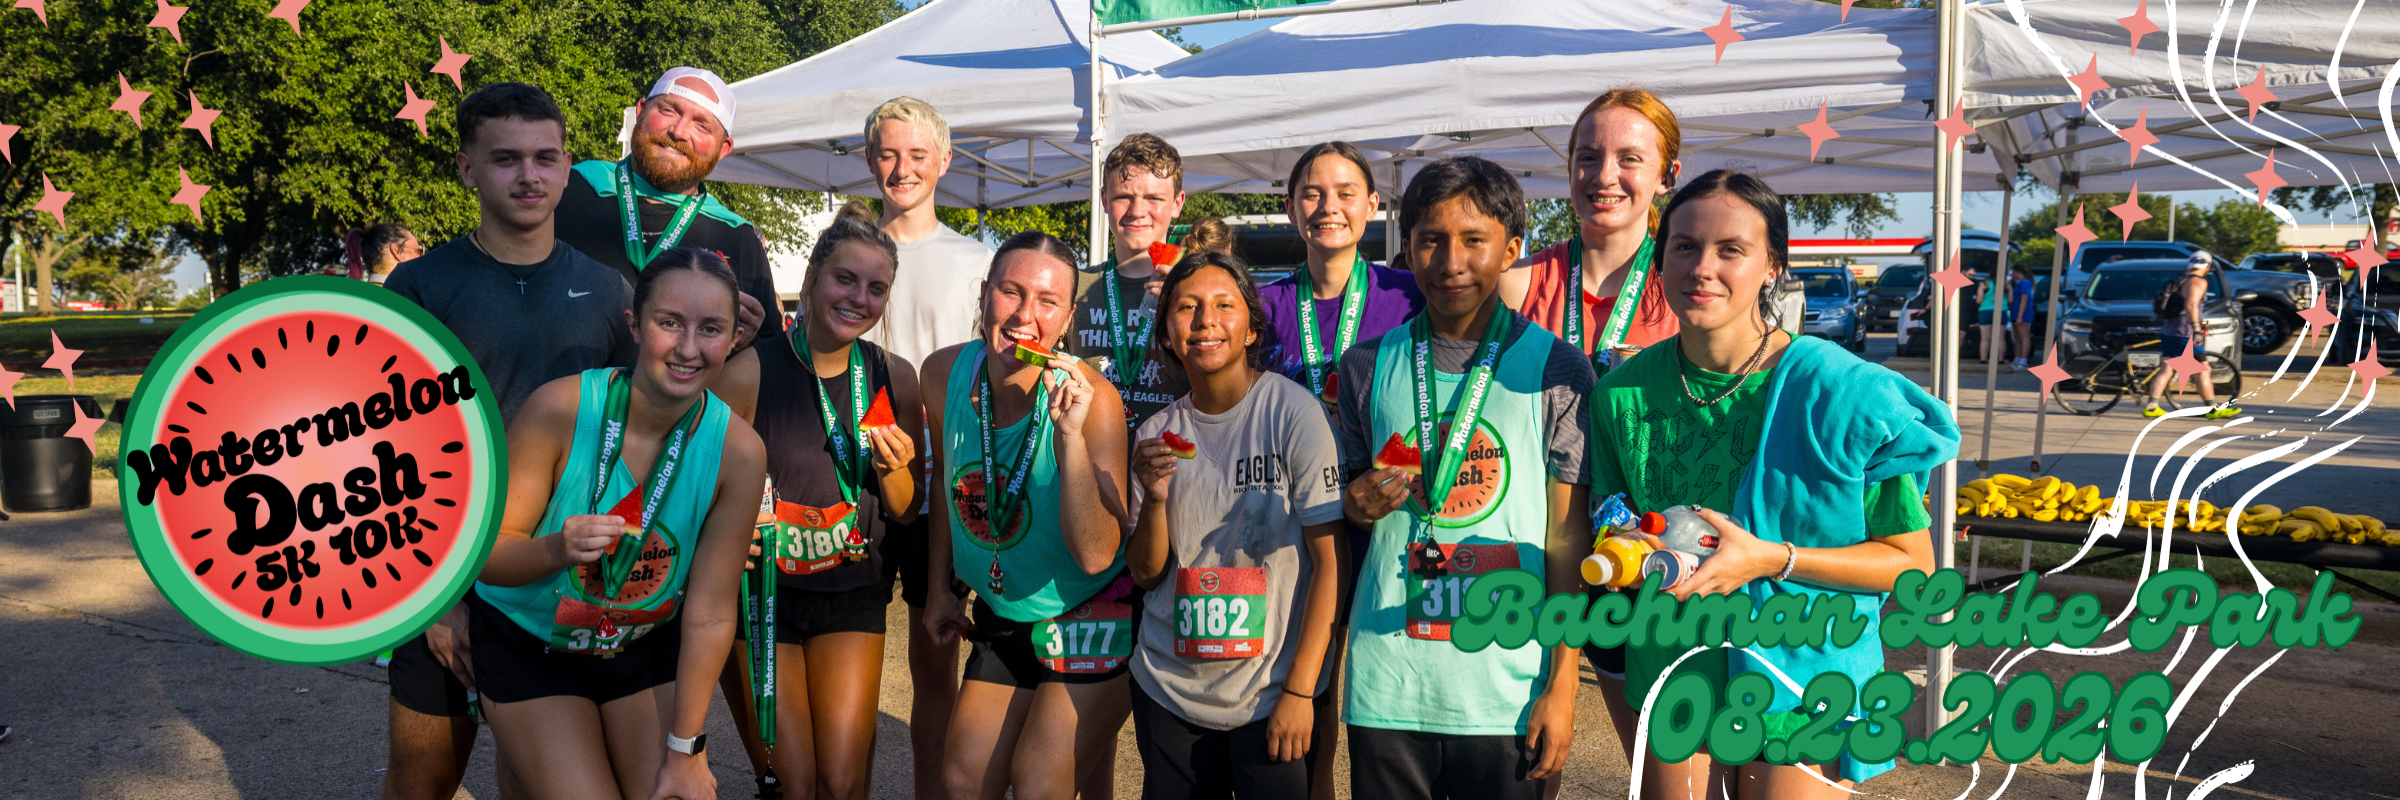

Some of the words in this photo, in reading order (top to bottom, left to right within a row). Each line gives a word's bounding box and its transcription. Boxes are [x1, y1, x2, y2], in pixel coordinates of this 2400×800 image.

[623, 185, 639, 241] Watermelon
[660, 201, 698, 251] Watermelon
[1568, 263, 1580, 332] Watermelon
[1627, 270, 1644, 297] Dash
[1105, 269, 1120, 323] Watermelon
[1114, 325, 1124, 346] Dash
[1346, 292, 1361, 318] Dash
[1136, 318, 1153, 347] Water
[1301, 299, 1318, 365] Watermelon
[1310, 367, 1324, 394] Dash
[1416, 340, 1431, 418] Watermelon
[1451, 372, 1489, 451] Watermelon
[1480, 341, 1500, 371] Dash
[1133, 392, 1175, 404] EAGLES
[981, 381, 991, 453] Watermelon
[667, 428, 684, 460] Dash
[833, 435, 847, 461] Dash
[1421, 421, 1433, 452] Dash
[985, 456, 993, 484] Dash
[1007, 425, 1039, 495] Watermelon
[1233, 486, 1247, 494] RIO
[787, 522, 850, 559] 3180
[748, 595, 759, 623] Dash
[765, 596, 774, 624] Dash
[1178, 597, 1250, 636] 3182
[1046, 622, 1116, 656] 3177
[764, 625, 774, 697] Watermelon
